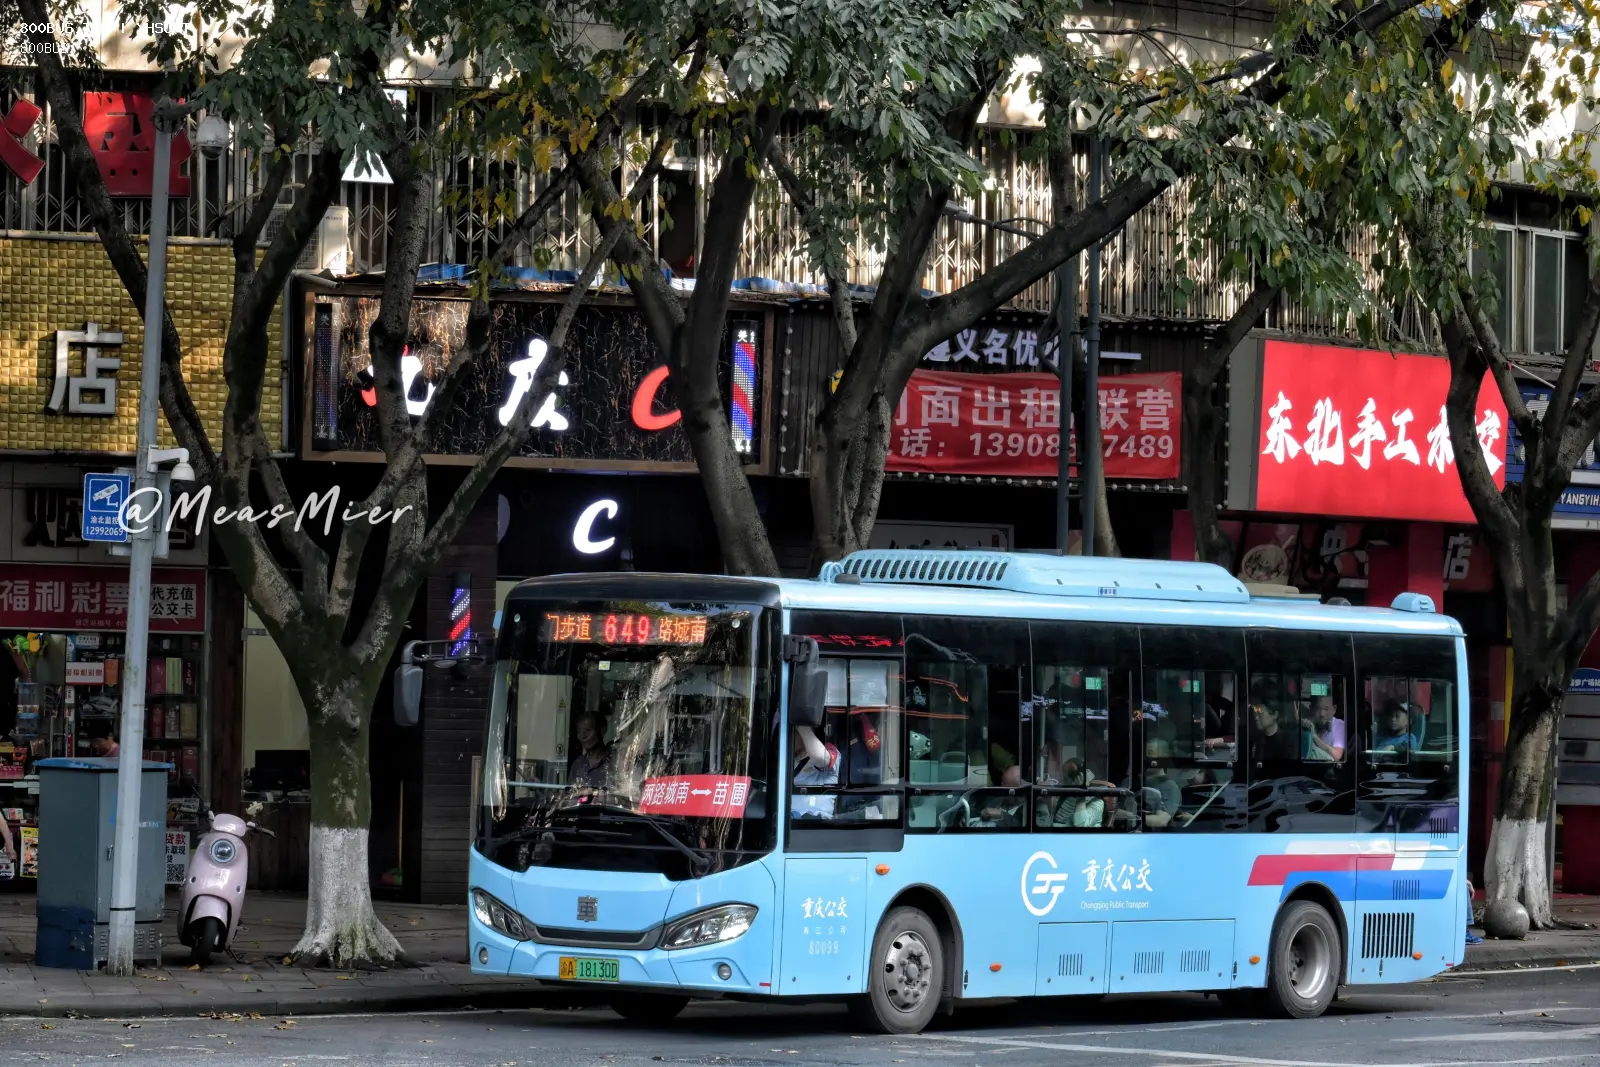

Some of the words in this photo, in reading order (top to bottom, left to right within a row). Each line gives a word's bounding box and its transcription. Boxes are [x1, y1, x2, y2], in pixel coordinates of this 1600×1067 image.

[48, 322, 124, 415] 店
[969, 432, 1173, 459] 139087489
[86, 526, 124, 536] 12992069
[151, 586, 195, 600] 代充值
[151, 602, 195, 616] 公交卡
[604, 613, 650, 643] 649
[641, 781, 691, 806] 两路城南
[1081, 858, 1153, 892] 重庆公交
[801, 896, 849, 919] 重庆公交
[1080, 901, 1109, 911] Chongqing
[1109, 901, 1125, 910] Public
[1126, 901, 1150, 911] Transport
